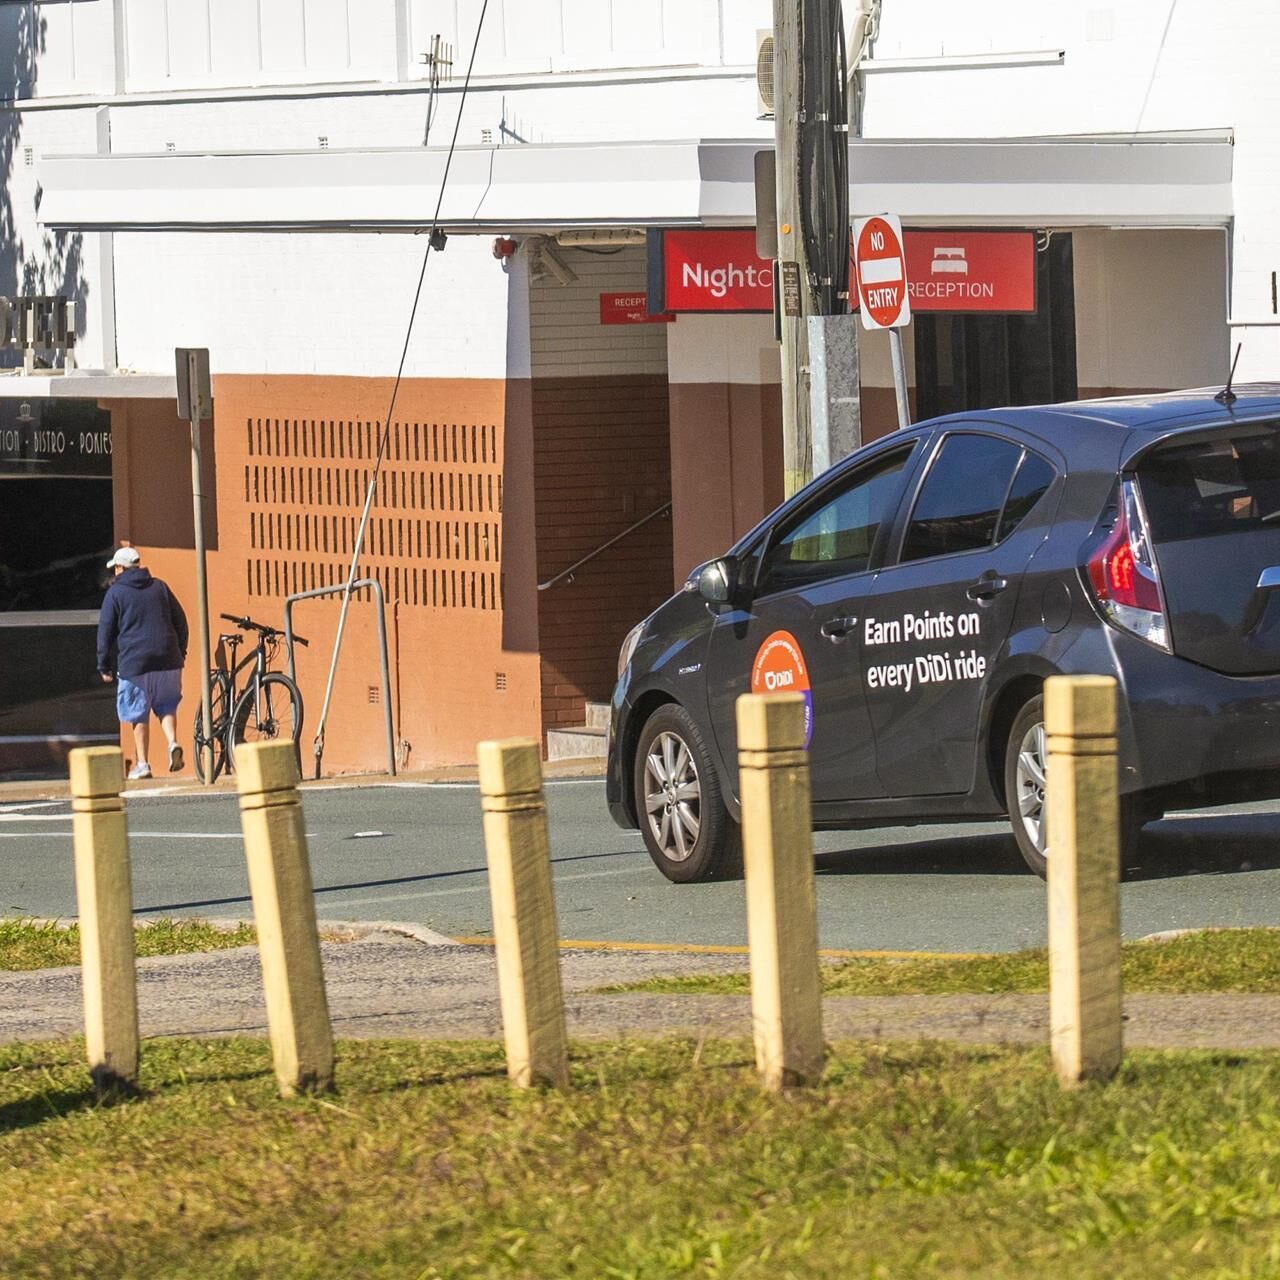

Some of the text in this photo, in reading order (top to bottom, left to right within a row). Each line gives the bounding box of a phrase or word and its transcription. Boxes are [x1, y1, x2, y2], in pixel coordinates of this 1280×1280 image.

[870, 231, 885, 251] NO
[683, 262, 772, 297] Nightc
[907, 282, 994, 298] RECEPTION
[868, 287, 898, 309] ENTRY
[34, 432, 66, 454] BISTRO
[80, 432, 112, 454] POKIES
[864, 610, 980, 645] Earn Points on
[867, 650, 986, 693] every DiDi ride
